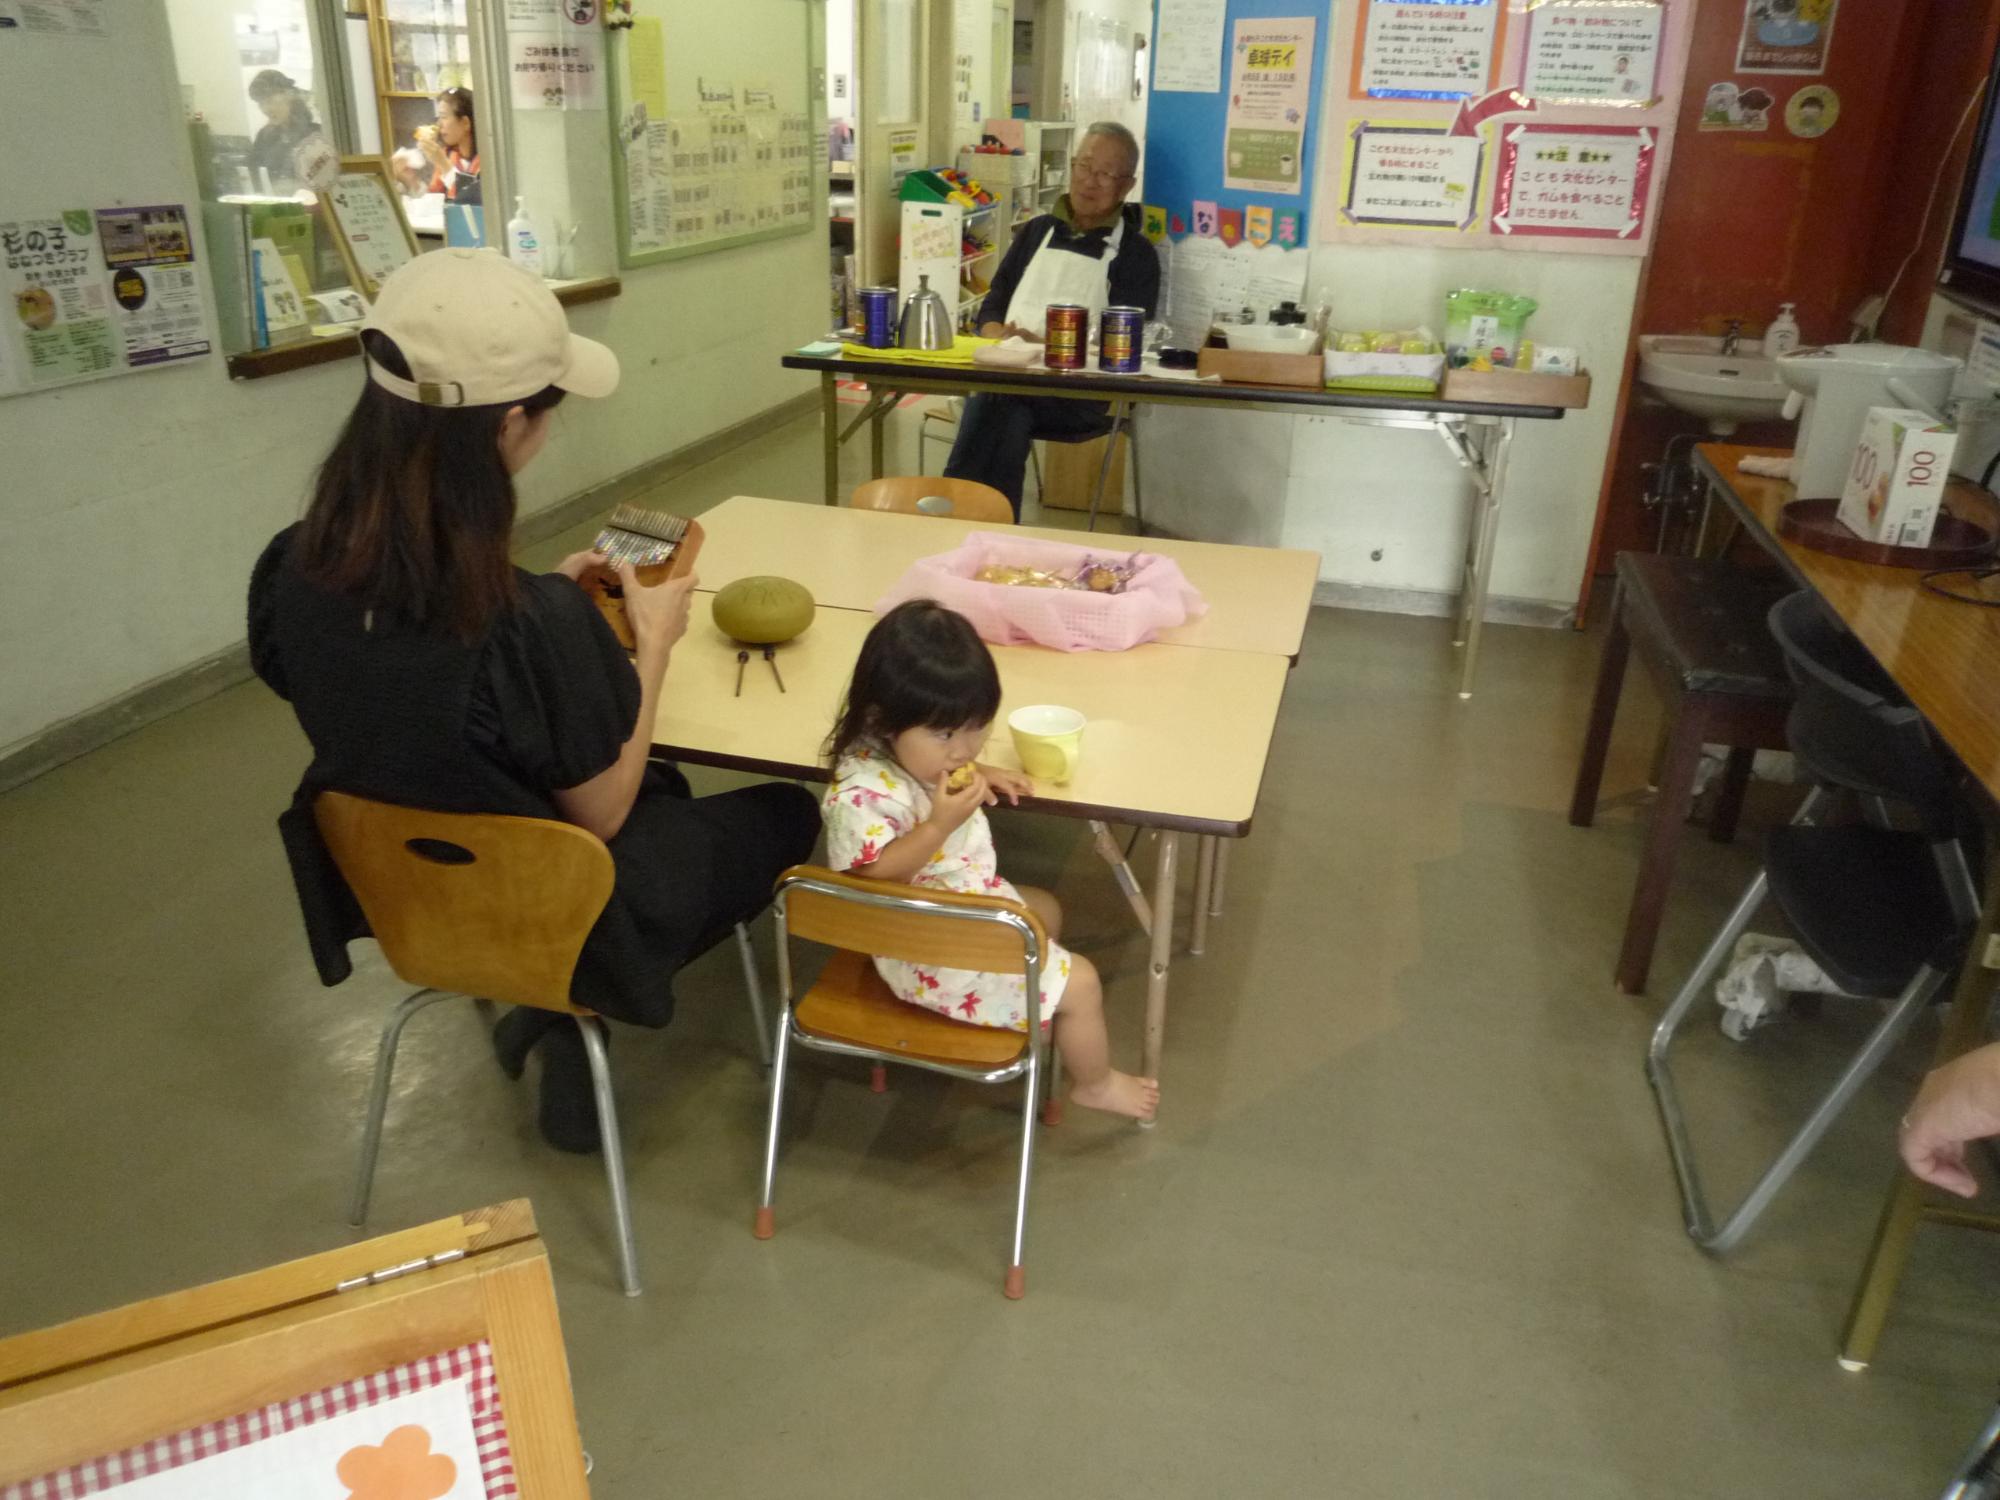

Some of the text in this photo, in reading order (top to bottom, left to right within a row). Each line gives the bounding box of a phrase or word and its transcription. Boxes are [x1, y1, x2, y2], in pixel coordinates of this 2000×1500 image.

[1369, 144, 1455, 156] こども文化センターから
[1520, 171, 1628, 185] こども文化センター
[1518, 190, 1625, 206] で、ガムを食べること
[1906, 450, 1937, 488] 100
